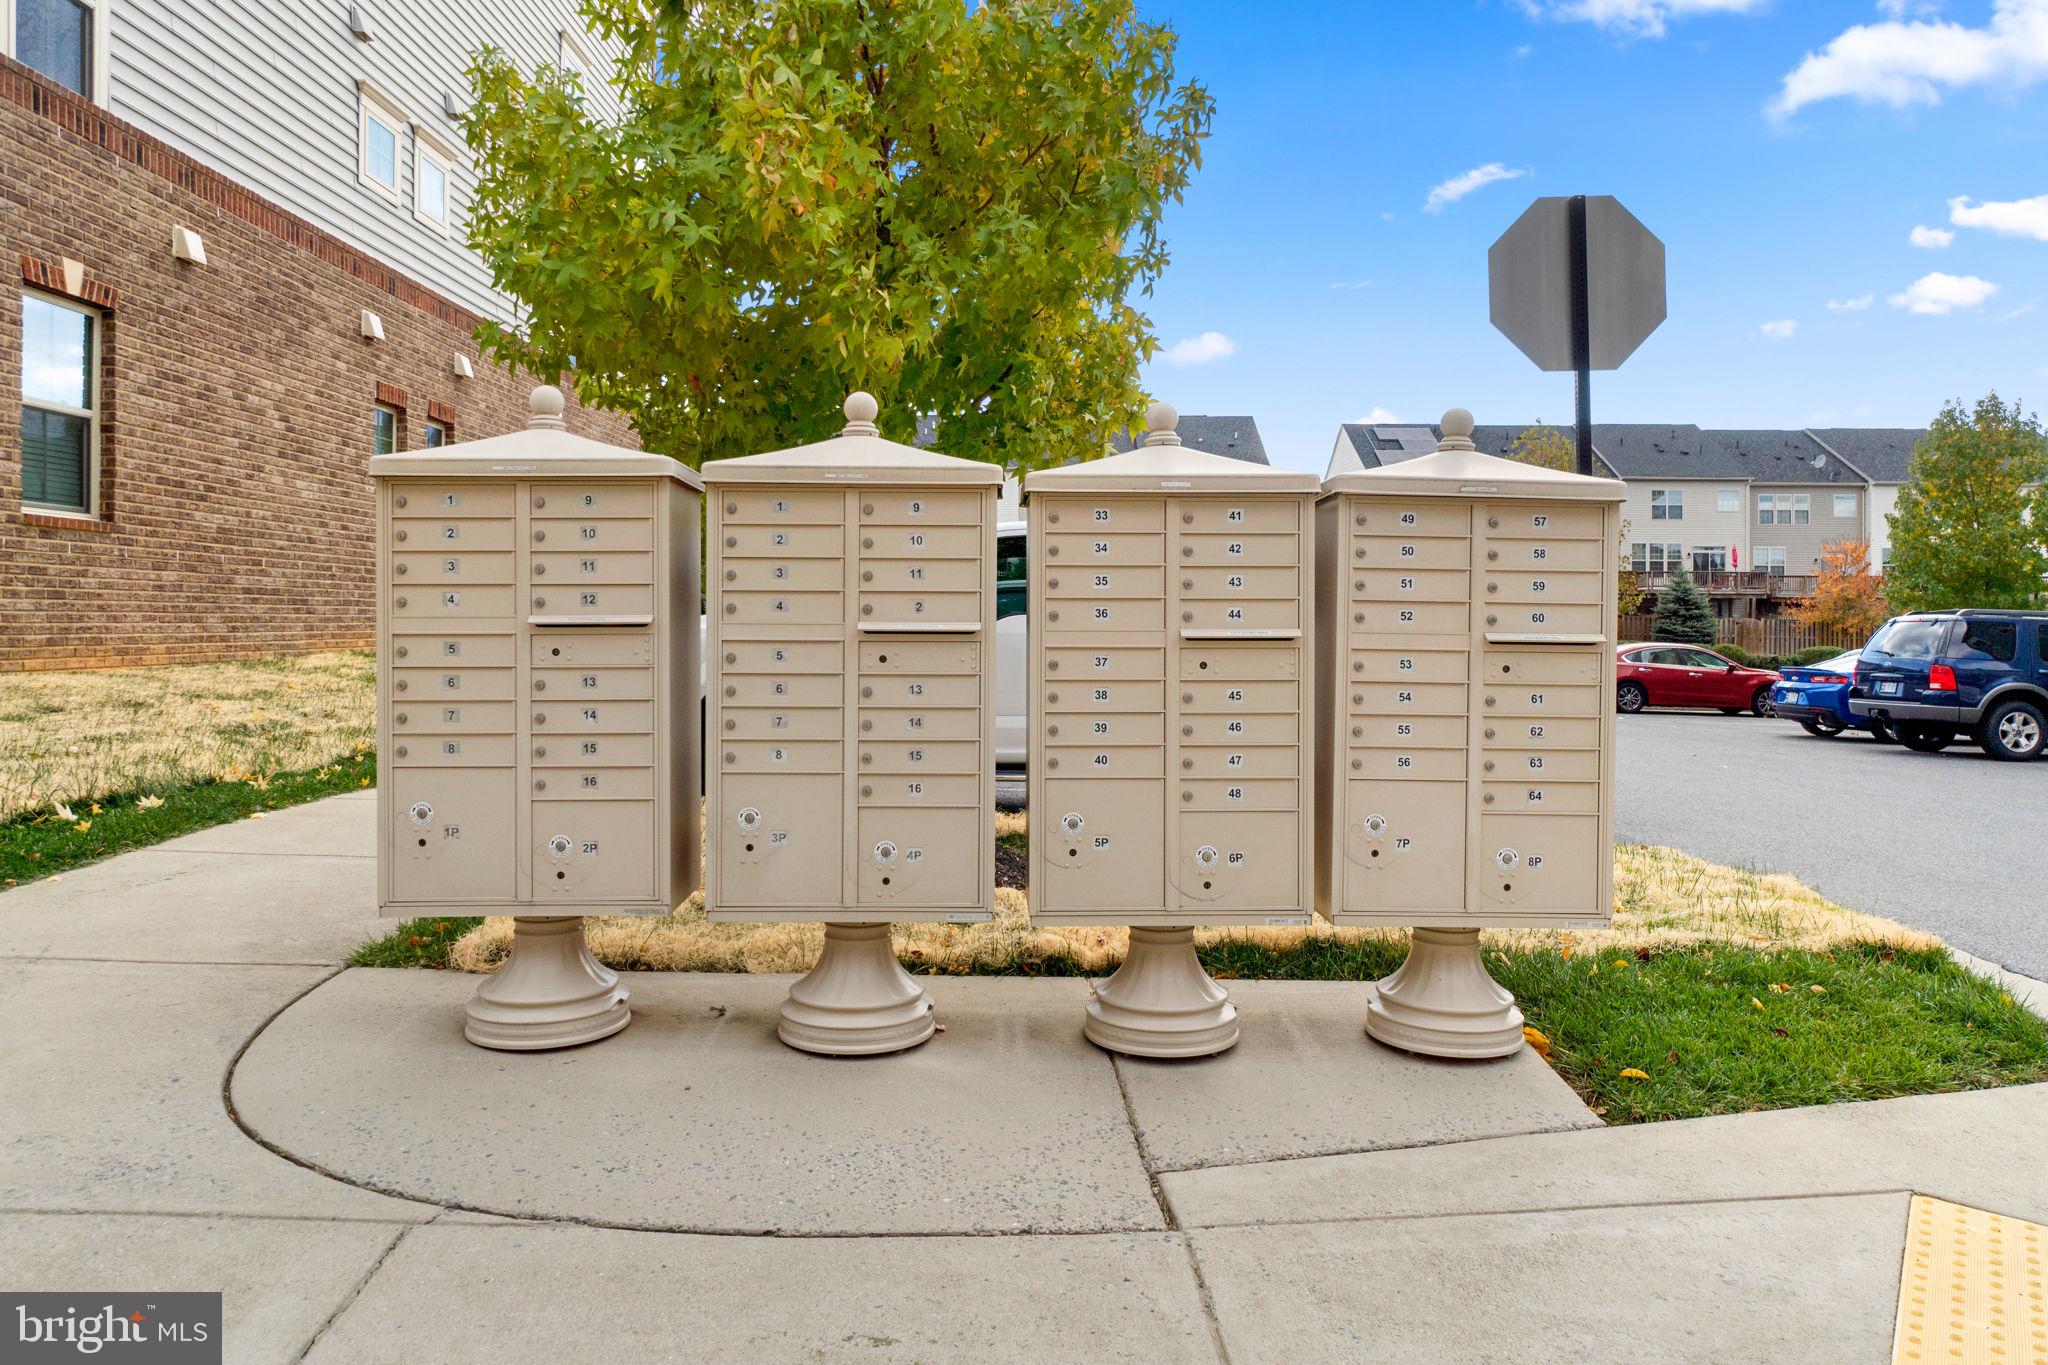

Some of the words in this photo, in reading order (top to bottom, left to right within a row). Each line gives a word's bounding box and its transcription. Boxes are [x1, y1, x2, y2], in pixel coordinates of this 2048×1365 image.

[1095, 510, 1108, 521] 33
[1229, 511, 1241, 521] 41
[1401, 514, 1415, 524] 49
[1534, 516, 1547, 527] 57
[582, 528, 596, 539] 10
[910, 535, 923, 546] 10
[1094, 543, 1108, 553] 34
[1228, 543, 1241, 554] 42
[1401, 546, 1414, 556] 50
[1533, 549, 1546, 559] 58
[582, 561, 594, 571] 11
[910, 568, 922, 579] 11
[1095, 576, 1108, 586] 35
[1228, 577, 1242, 587] 43
[1401, 578, 1412, 589] 51
[1532, 581, 1545, 591] 59
[582, 594, 596, 605] 12
[1095, 608, 1108, 618] 36
[1228, 609, 1242, 619] 44
[1400, 611, 1413, 621] 52
[1531, 613, 1545, 623] 60
[1094, 657, 1108, 667] 37
[1399, 659, 1412, 669] 53
[582, 677, 596, 687] 13
[909, 684, 922, 695] 13
[1094, 690, 1108, 700] 38
[1228, 691, 1242, 701] 45
[1399, 692, 1412, 702] 54
[1531, 694, 1543, 704] 61
[583, 710, 597, 720] 14
[908, 717, 922, 728] 14
[1094, 722, 1107, 733] 39
[1228, 722, 1242, 732] 46
[1397, 725, 1411, 735] 55
[1530, 726, 1543, 737] 62
[583, 743, 597, 754] 15
[909, 750, 922, 761] 15
[1094, 755, 1108, 765] 40
[1228, 755, 1242, 766] 47
[1398, 757, 1411, 767] 56
[1529, 758, 1543, 768] 63
[583, 776, 597, 787] 16
[908, 783, 922, 794] 16
[1228, 788, 1242, 798] 48
[1529, 790, 1542, 801] 64
[444, 827, 460, 837] 1P
[772, 833, 787, 843] 3P
[1094, 837, 1109, 848] 5P
[1396, 838, 1410, 848] 7P
[582, 843, 598, 853] 2P
[906, 850, 922, 860] 4P
[1229, 853, 1243, 863] 6P
[1528, 856, 1542, 867] 8P
